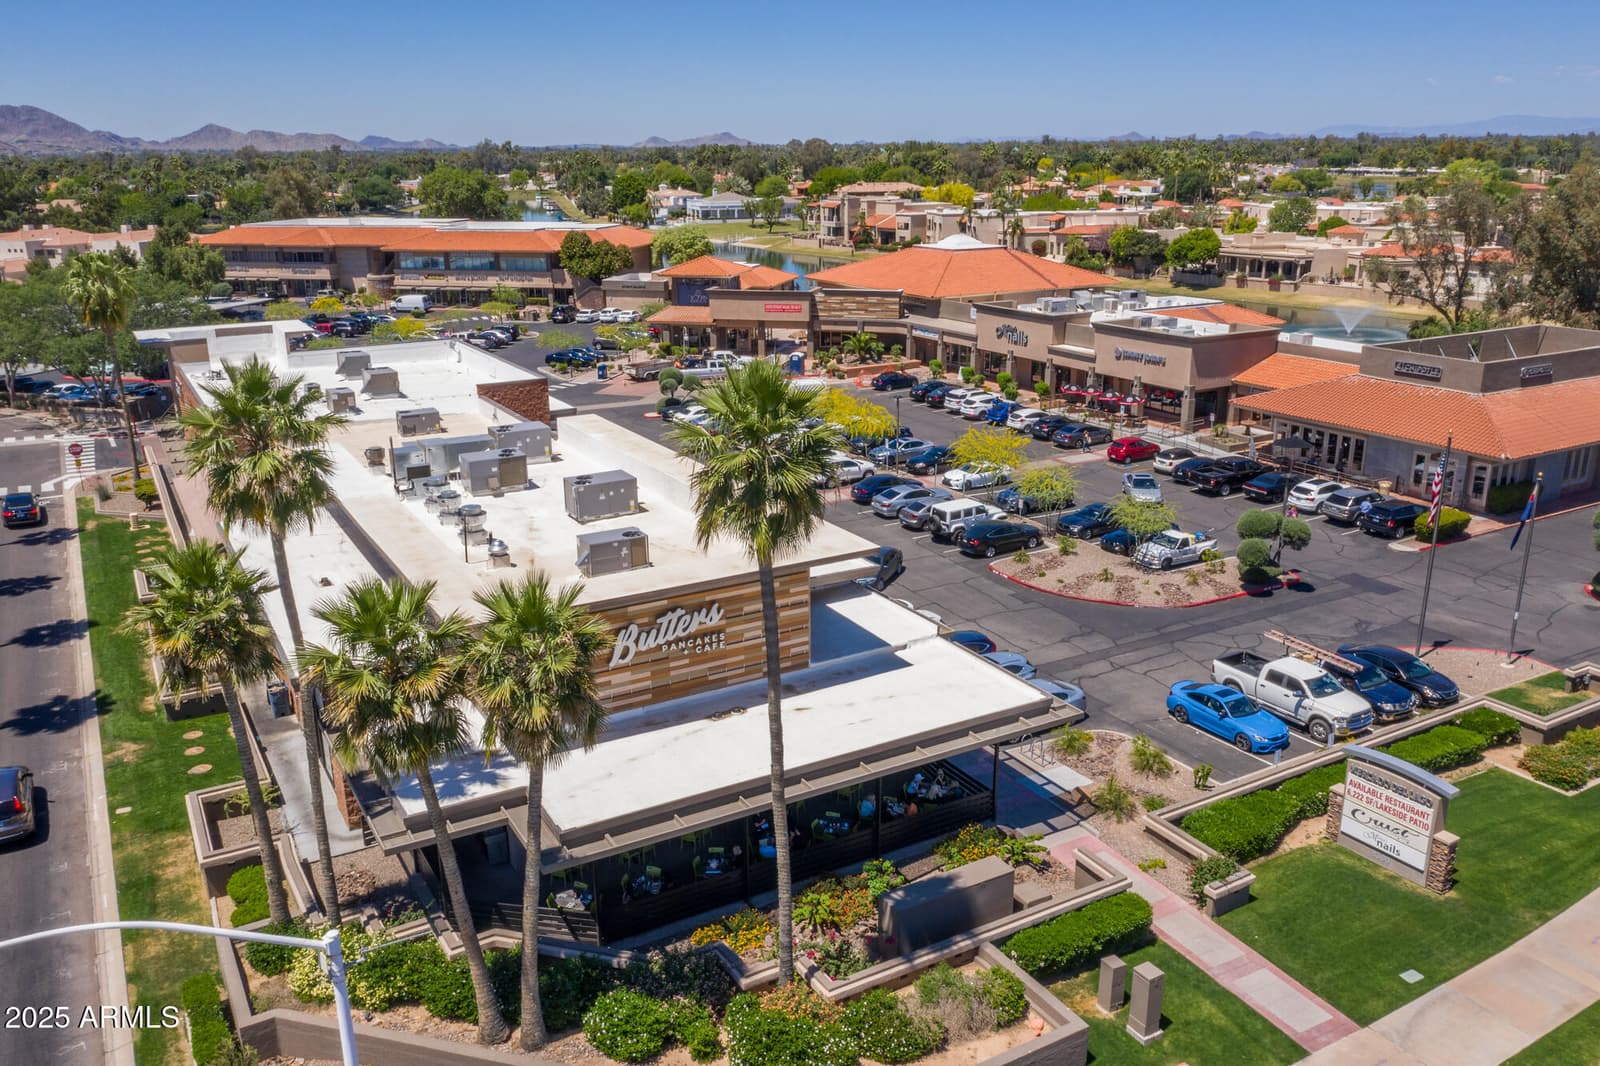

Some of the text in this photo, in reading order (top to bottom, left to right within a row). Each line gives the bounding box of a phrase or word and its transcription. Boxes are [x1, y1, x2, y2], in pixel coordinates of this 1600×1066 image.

[1007, 330, 1029, 347] nails
[609, 602, 724, 670] Butters
[662, 632, 726, 653] PANCAKES
[695, 641, 726, 654] CAFE
[1349, 779, 1431, 820] AVAILABLE RESTAURANT
[1365, 795, 1407, 822] SF/LAKESIDE
[1409, 817, 1429, 832] PATIO
[1376, 838, 1401, 857] nails
